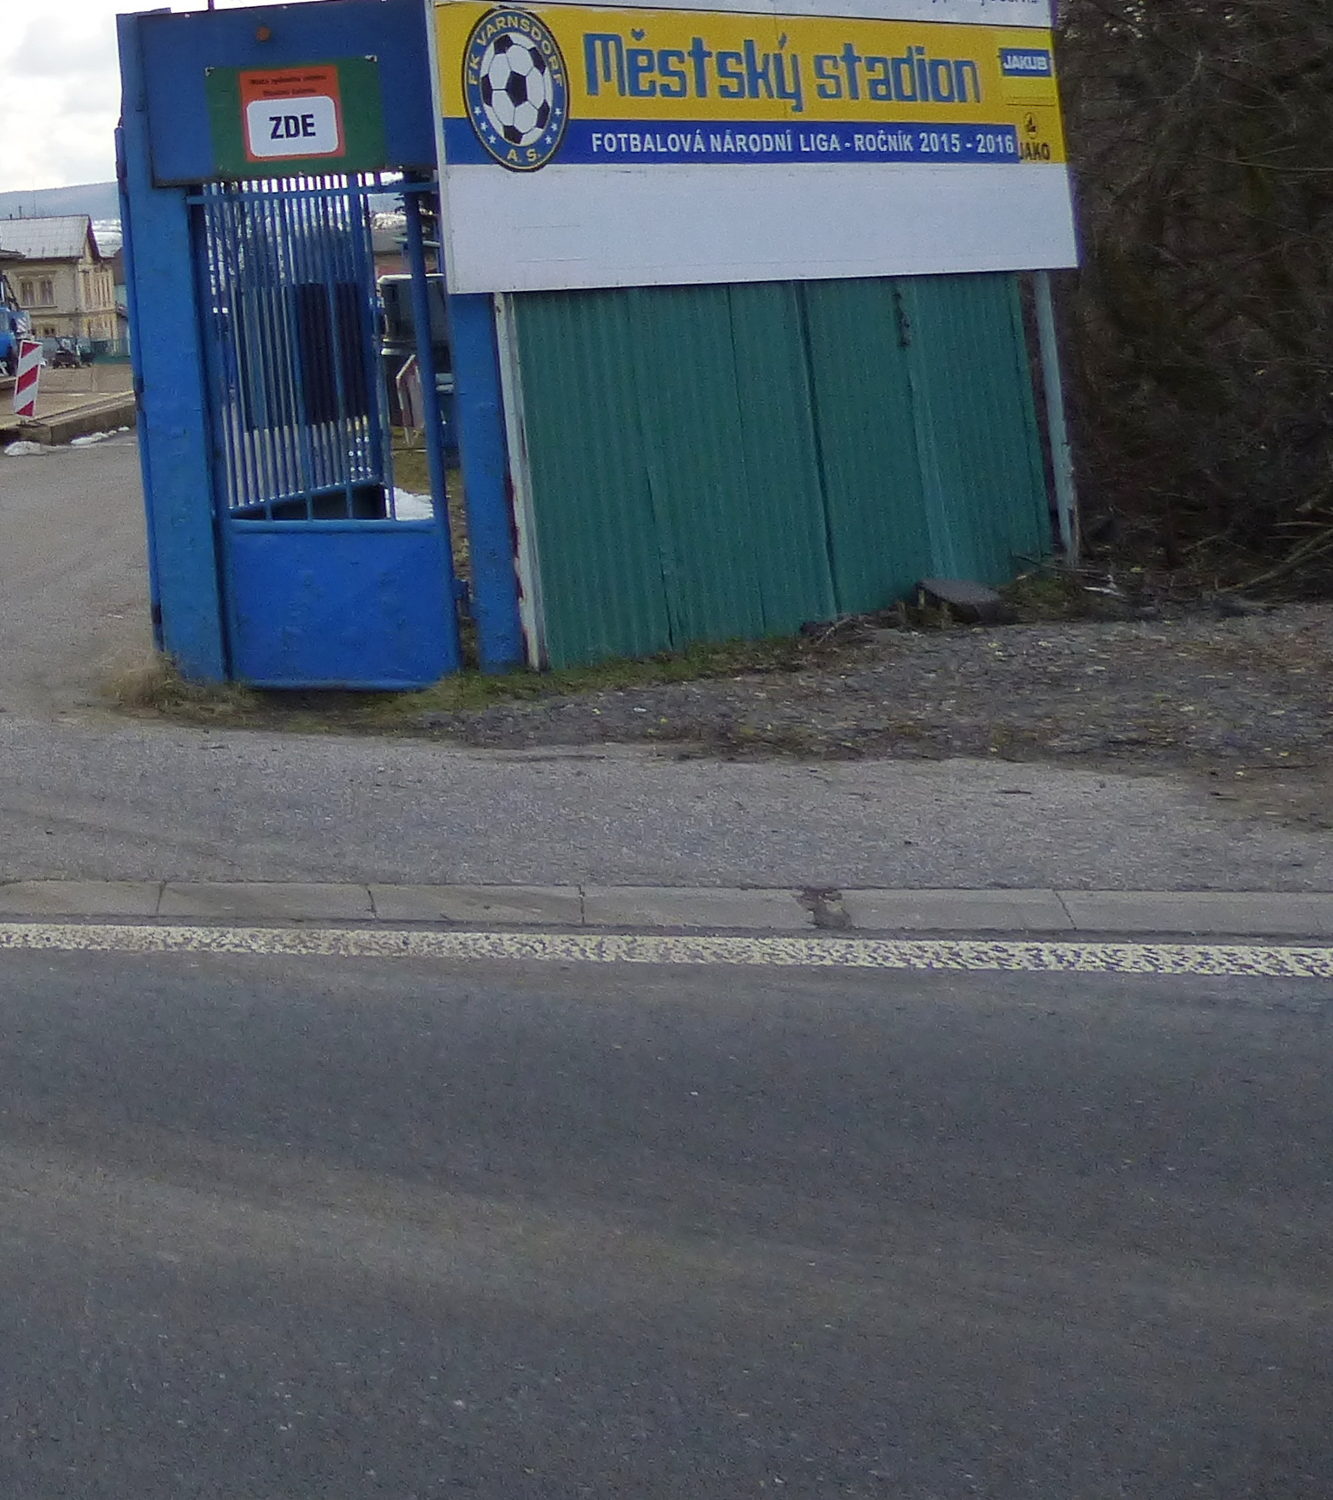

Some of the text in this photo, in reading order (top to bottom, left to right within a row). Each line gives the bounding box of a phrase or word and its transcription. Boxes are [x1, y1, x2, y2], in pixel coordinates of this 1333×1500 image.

[468, 14, 563, 88] FK VARNSDORF
[1002, 55, 1049, 71] JAKUB
[582, 28, 983, 113] Městský stadion
[268, 113, 317, 140] ZDE
[590, 129, 706, 153] FOTBALOVÁ
[709, 129, 794, 153] NÁRODNÍ
[799, 133, 841, 152] LIGA
[853, 129, 915, 153] ROČNÍK
[919, 132, 961, 154] 2015
[975, 133, 1016, 155] 2016
[1017, 141, 1051, 161] JAKO
